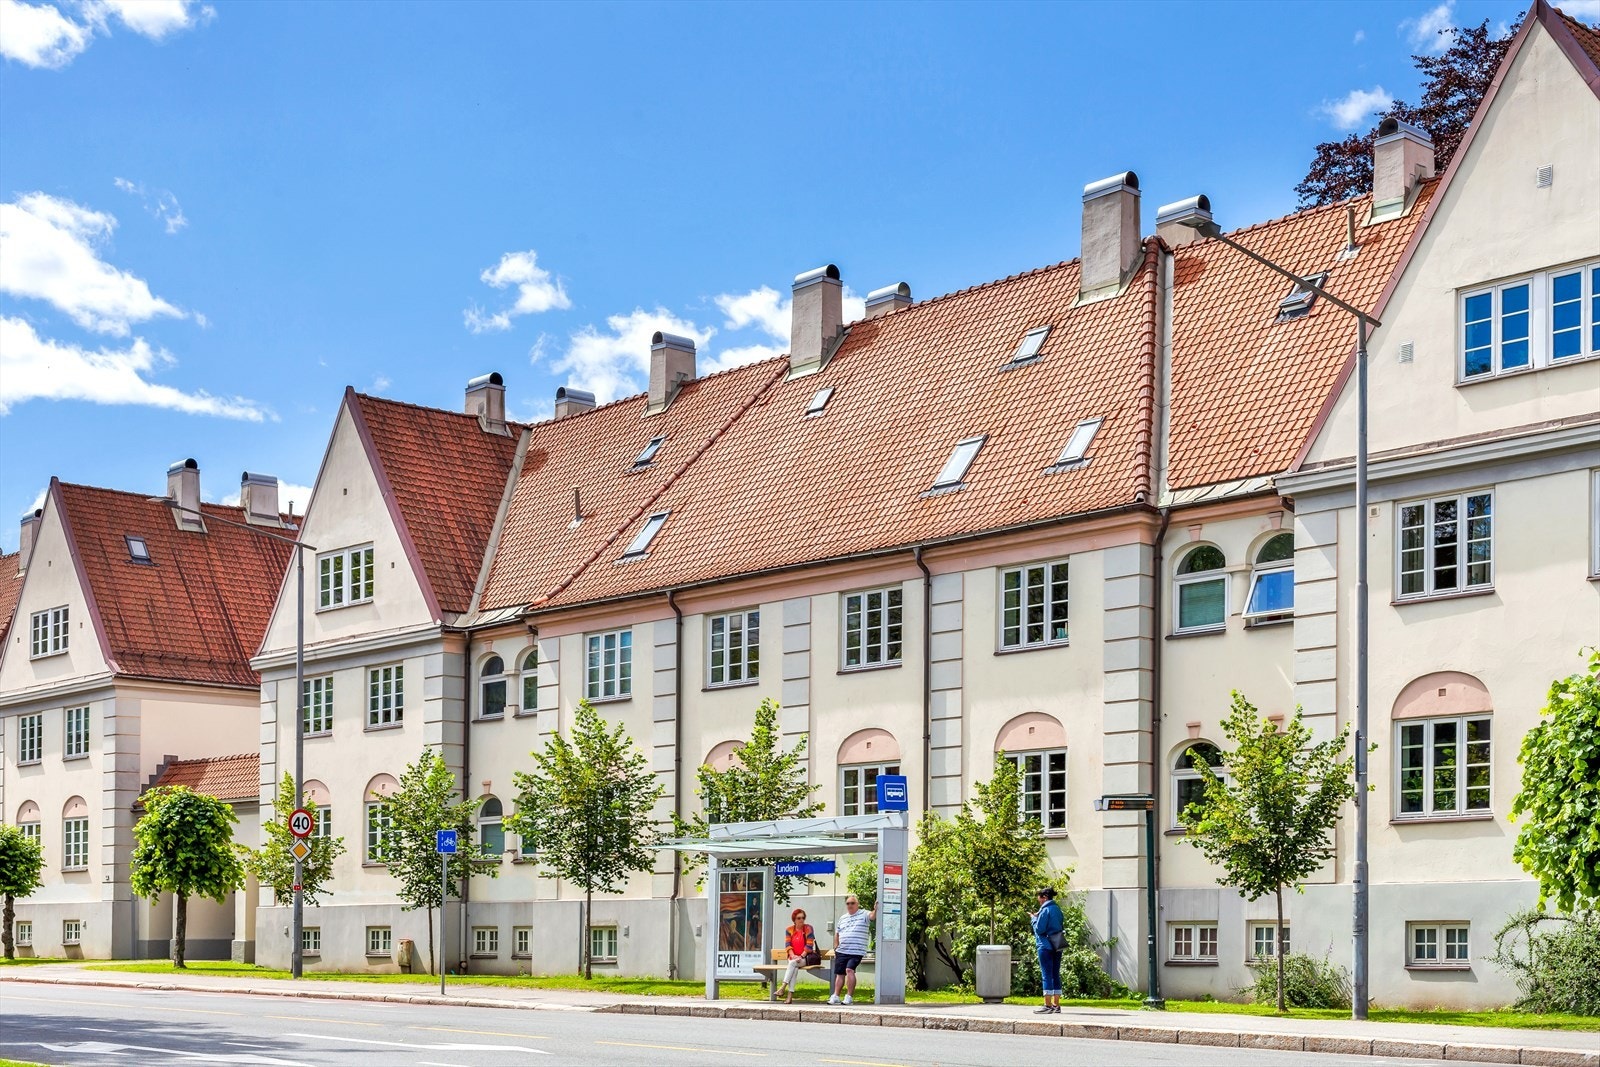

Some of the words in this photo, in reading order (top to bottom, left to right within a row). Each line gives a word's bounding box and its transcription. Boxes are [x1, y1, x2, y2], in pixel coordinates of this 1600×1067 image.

[293, 816, 310, 830] 40
[777, 863, 799, 873] Lindern
[717, 954, 740, 968] EXIT!
